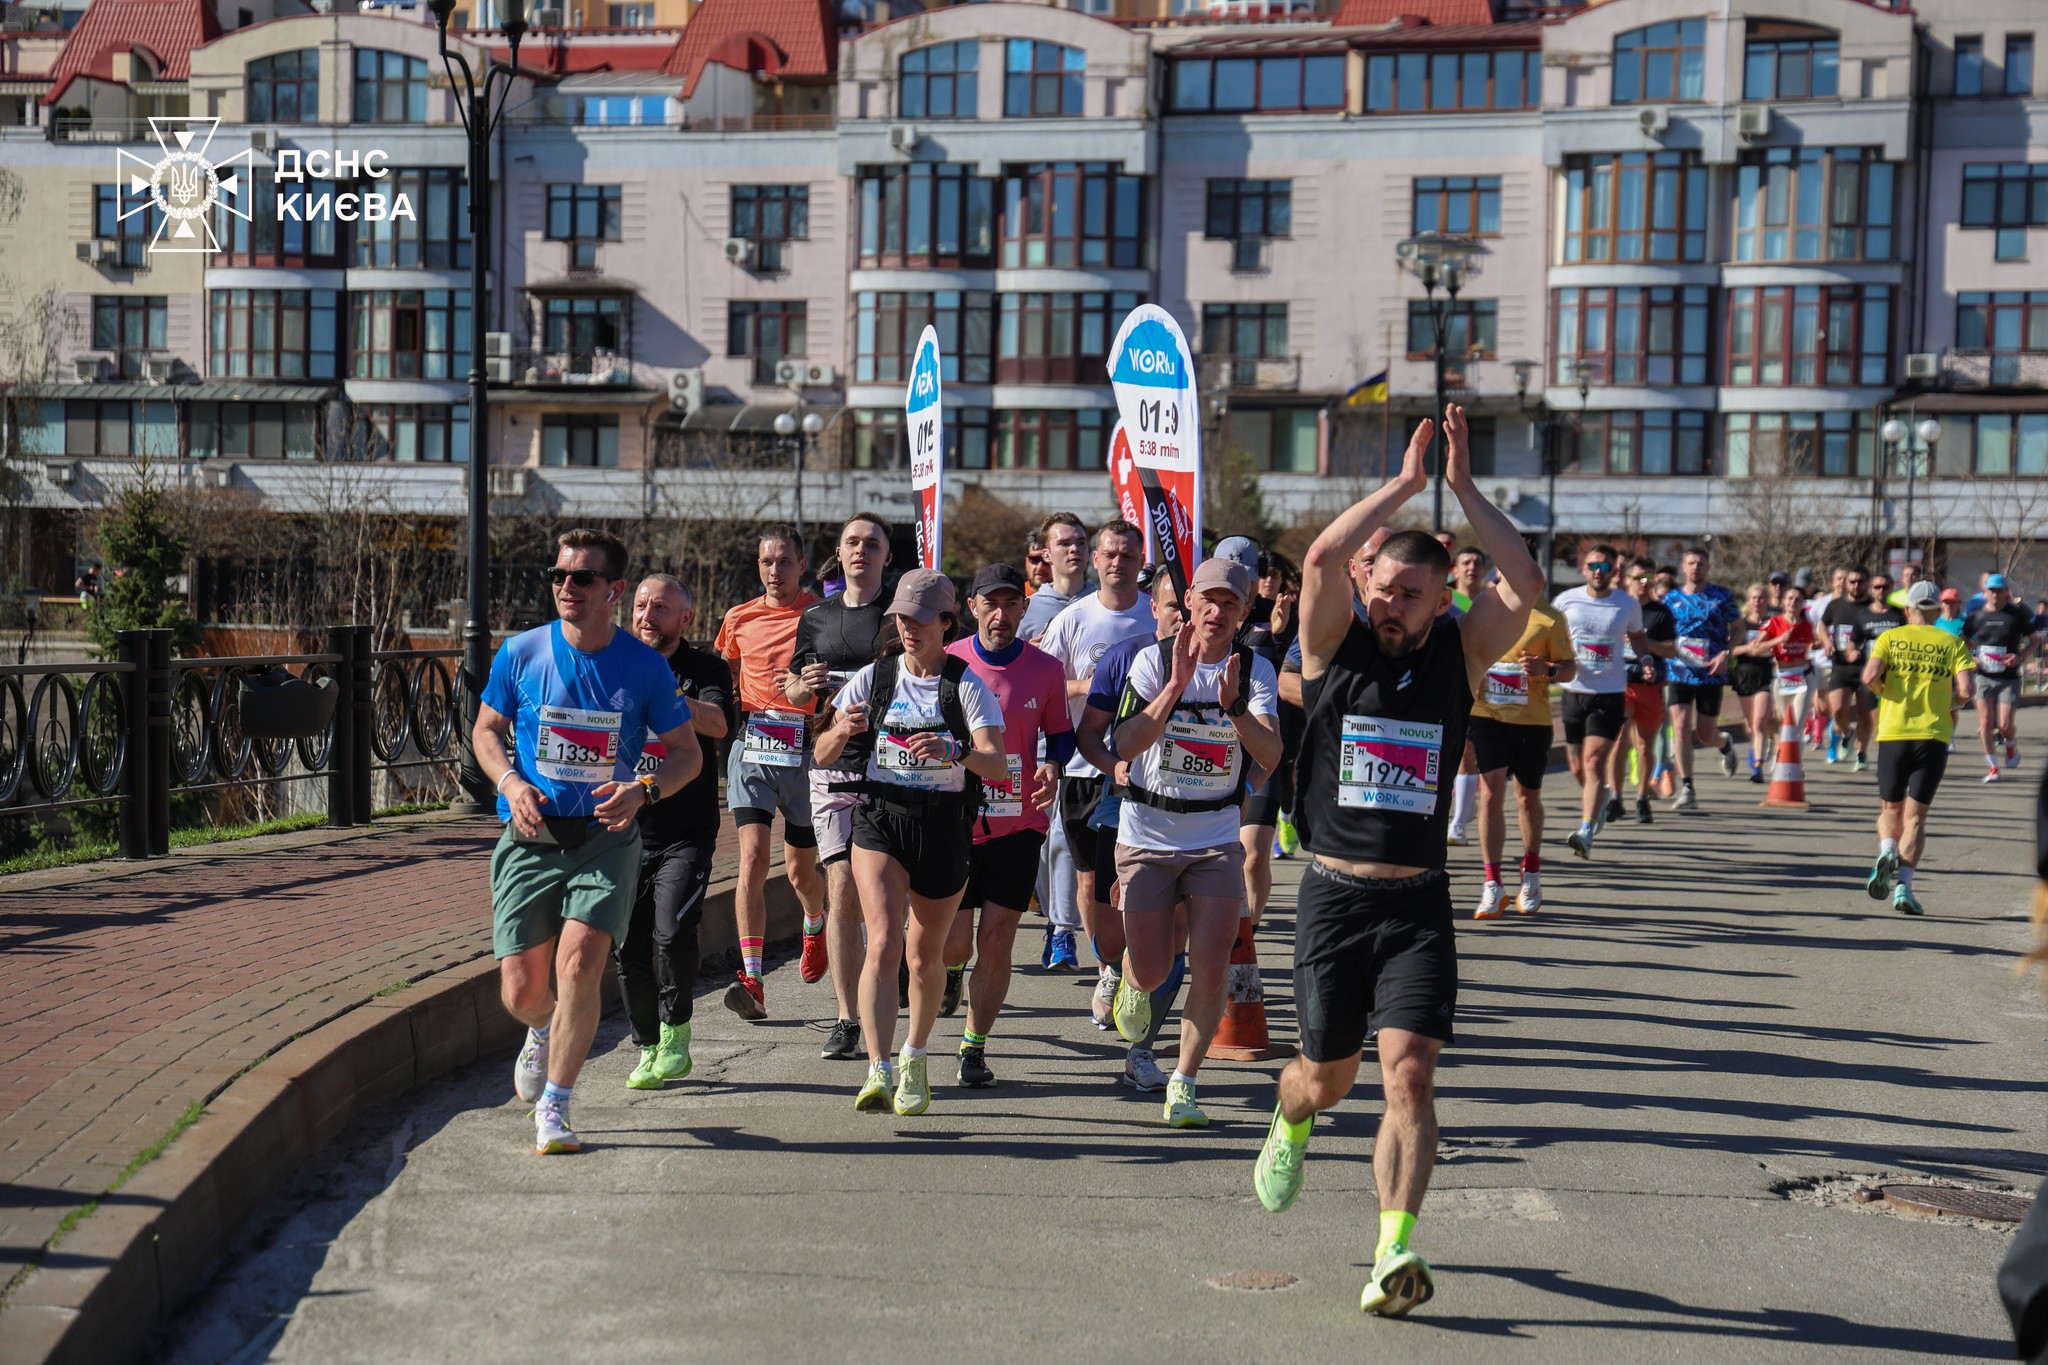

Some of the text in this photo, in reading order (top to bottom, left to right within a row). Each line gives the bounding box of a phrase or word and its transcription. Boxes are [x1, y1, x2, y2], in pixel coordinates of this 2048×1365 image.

[1890, 640, 1950, 656] FOLLOW
[1890, 651, 1948, 665] THE LEADERS
[546, 711, 616, 724] PUMA NOVUS
[1171, 725, 1191, 734] PUMA
[1351, 723, 1434, 739] PUMA NOVUS
[758, 736, 789, 750] 1125
[557, 743, 601, 762] 1333
[1182, 755, 1215, 772] 858
[555, 766, 597, 779] WORK.ua
[895, 773, 934, 782] WORK.ua
[1364, 761, 1417, 787] 1972
[1176, 776, 1214, 787] WORK.ua
[1363, 791, 1414, 806] WORK.ua
